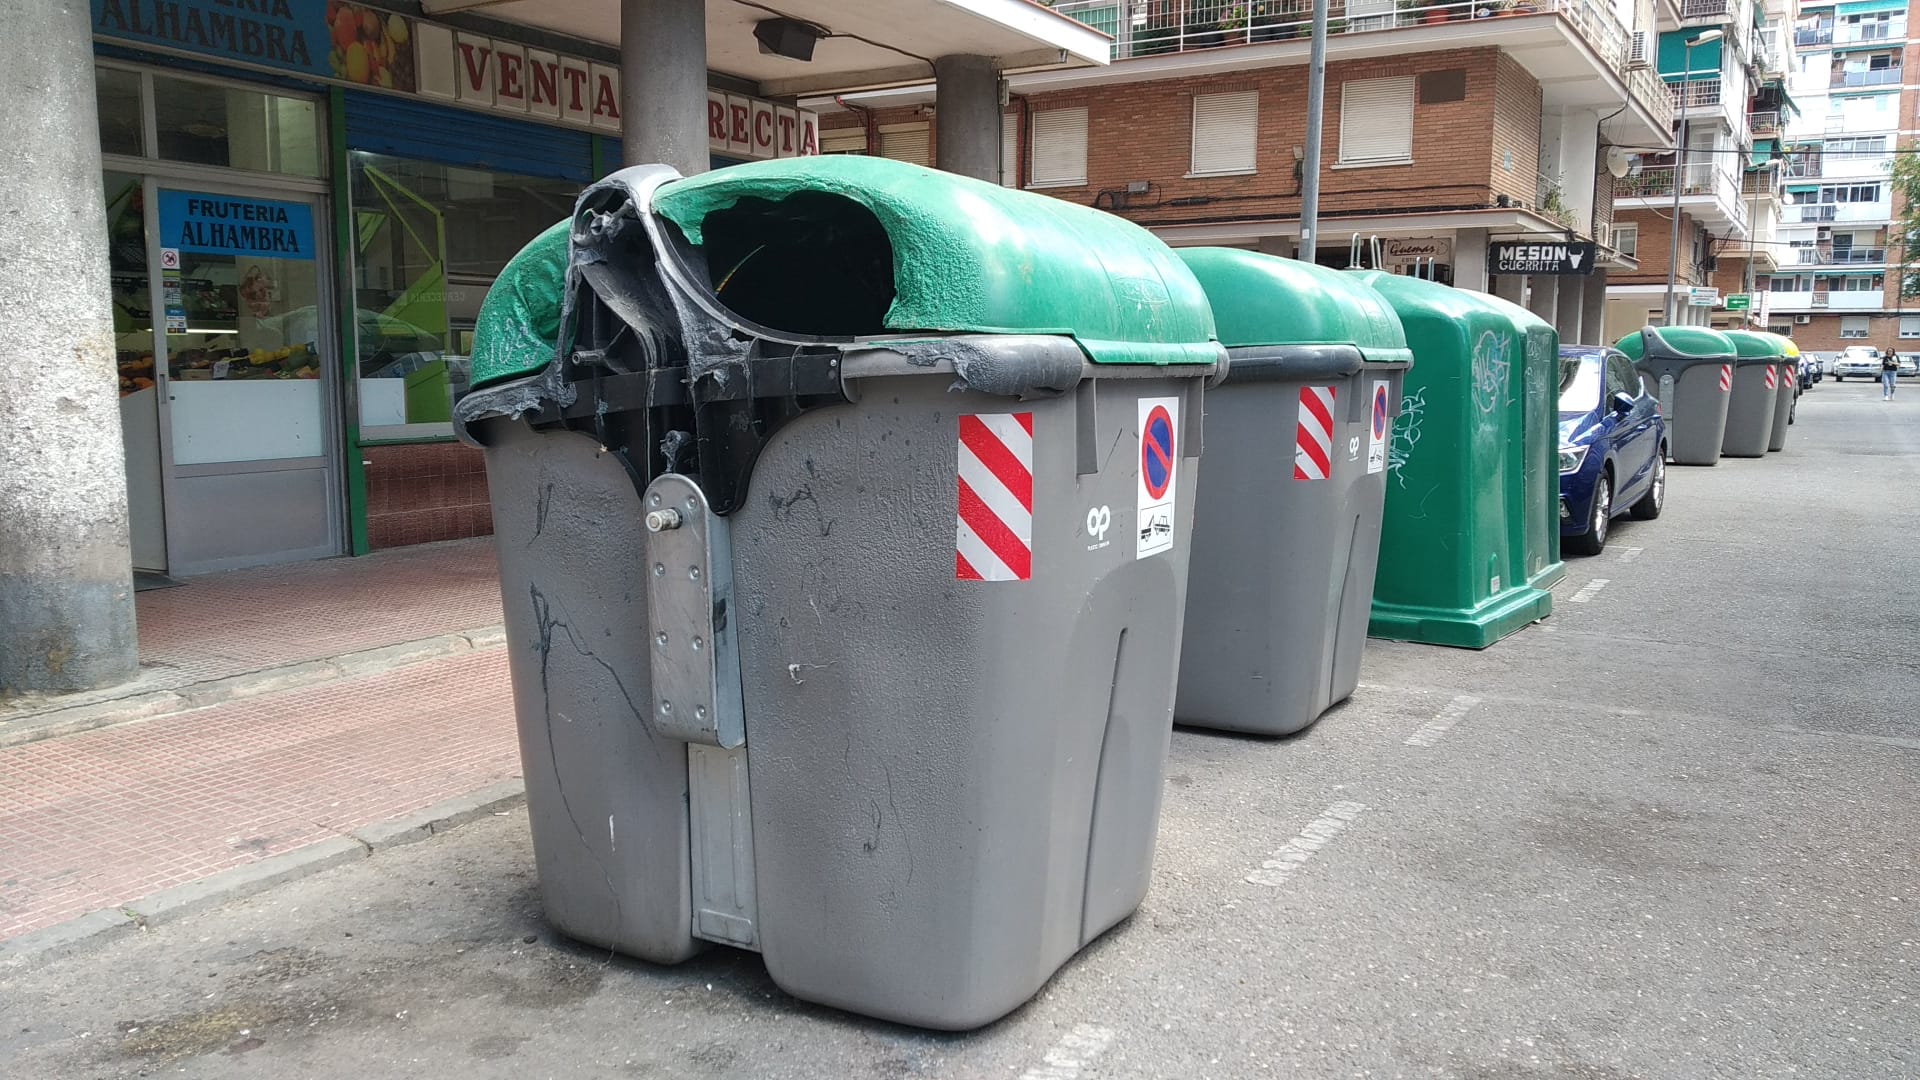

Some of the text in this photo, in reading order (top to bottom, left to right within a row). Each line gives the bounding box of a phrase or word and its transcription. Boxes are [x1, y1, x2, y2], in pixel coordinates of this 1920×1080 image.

[98, 0, 313, 66] ALHAMBRA
[458, 42, 819, 156] VENTA RECTA
[187, 198, 289, 224] FRUTERIA
[180, 220, 300, 253] ALHAMBRA
[1498, 260, 1560, 271] GUERRITA
[1499, 245, 1567, 261] MESON
